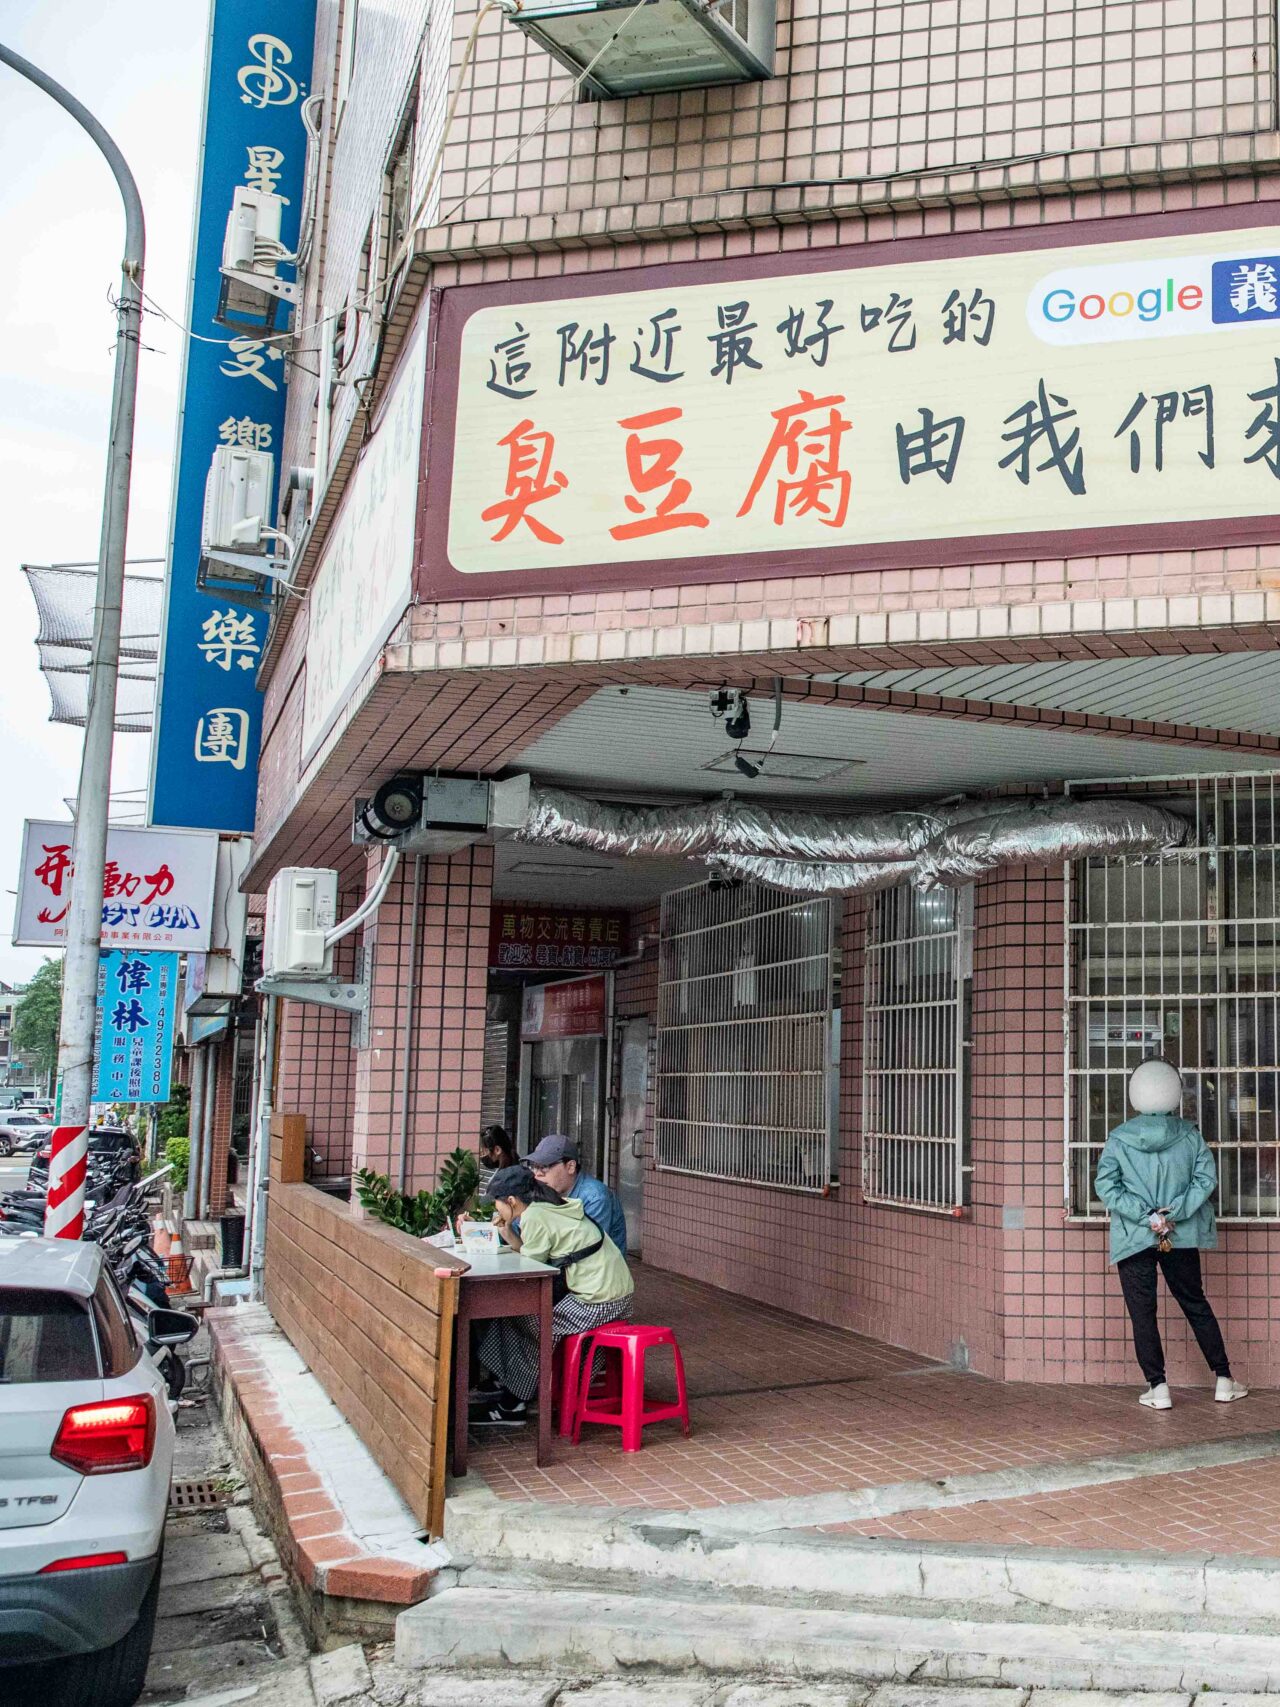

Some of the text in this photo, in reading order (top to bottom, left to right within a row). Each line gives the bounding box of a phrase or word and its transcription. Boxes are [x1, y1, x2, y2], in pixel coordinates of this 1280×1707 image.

[1041, 277, 1204, 323] Google
[486, 287, 996, 400] 這附近最好吃的
[110, 959, 152, 1034] 偉林
[110, 1037, 126, 1099] 服務中心
[14, 1495, 59, 1506] TFSI
